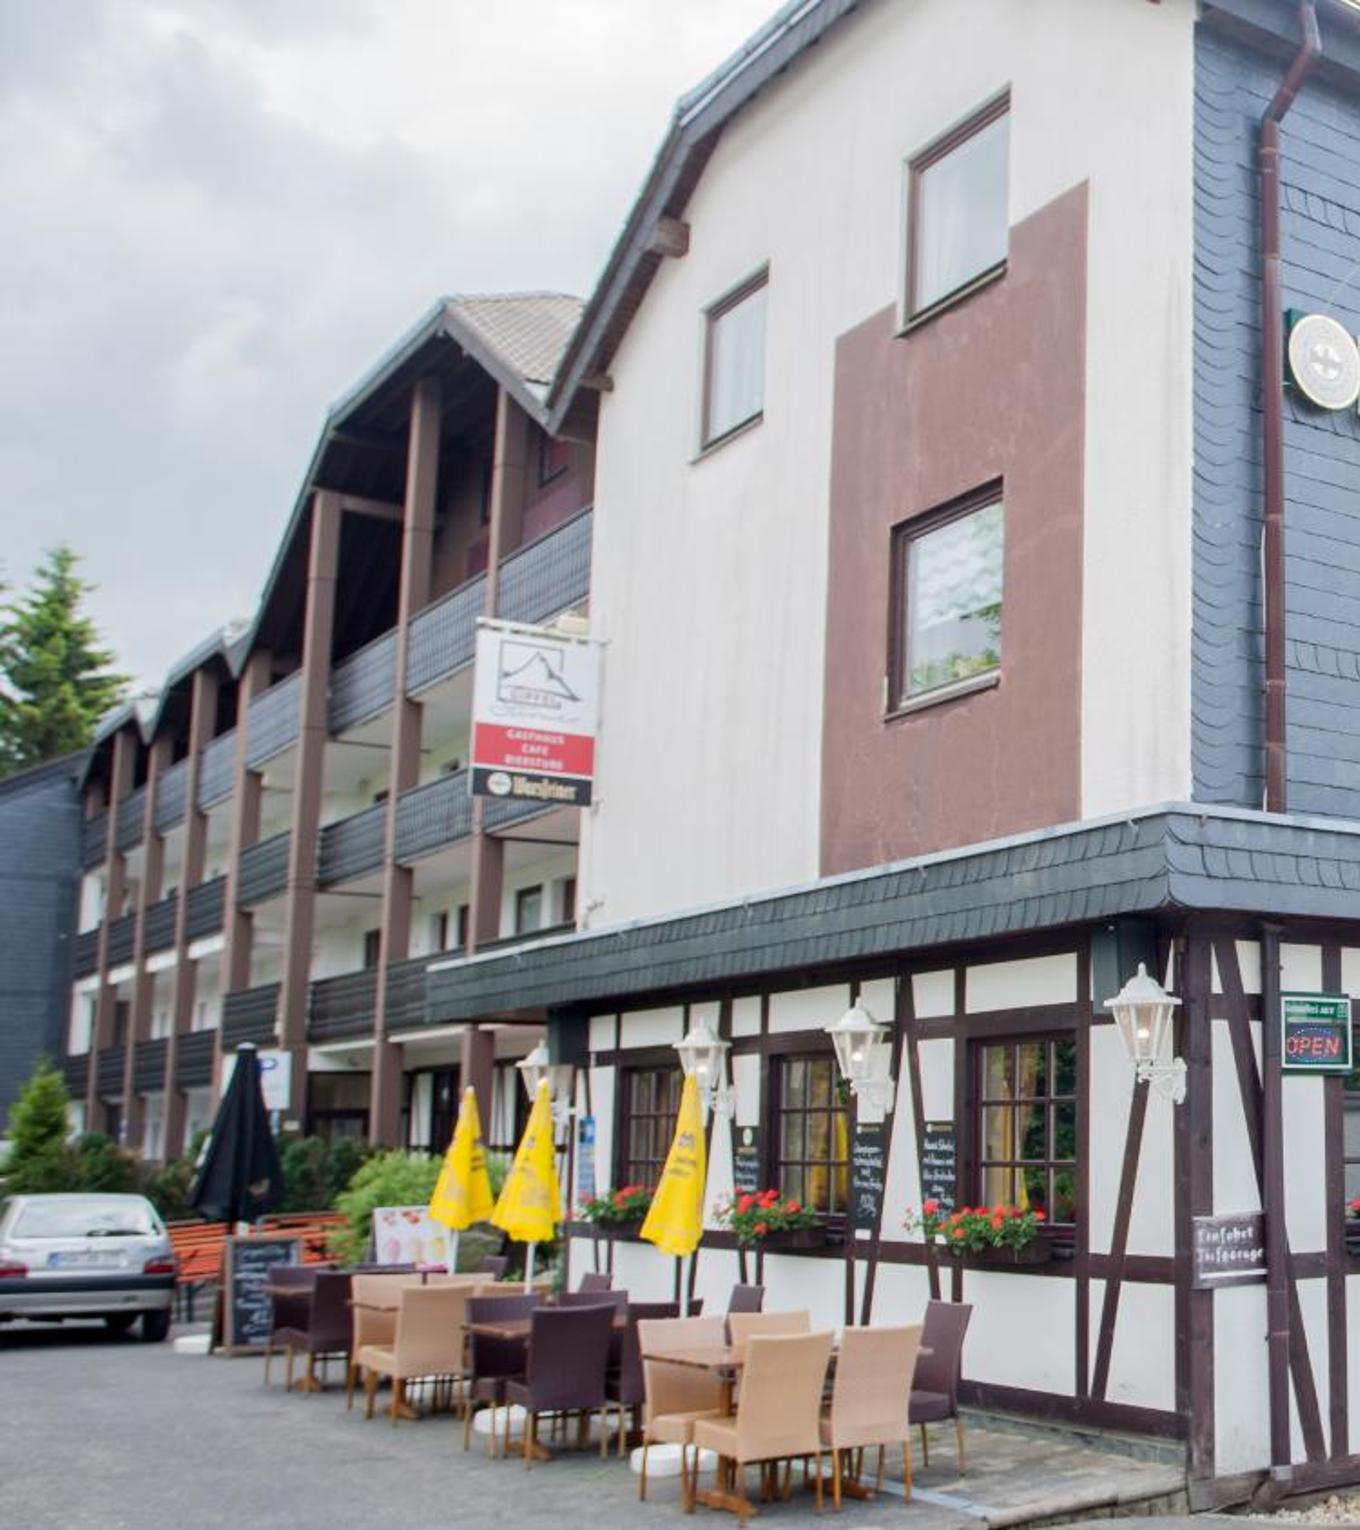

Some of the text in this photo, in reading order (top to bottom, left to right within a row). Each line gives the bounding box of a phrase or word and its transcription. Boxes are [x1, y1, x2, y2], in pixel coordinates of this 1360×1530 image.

[506, 728, 565, 745] GASTHAUS
[521, 743, 549, 756] CAFE
[504, 753, 563, 771] BIERSTUBE
[1286, 1036, 1341, 1056] OPEN
